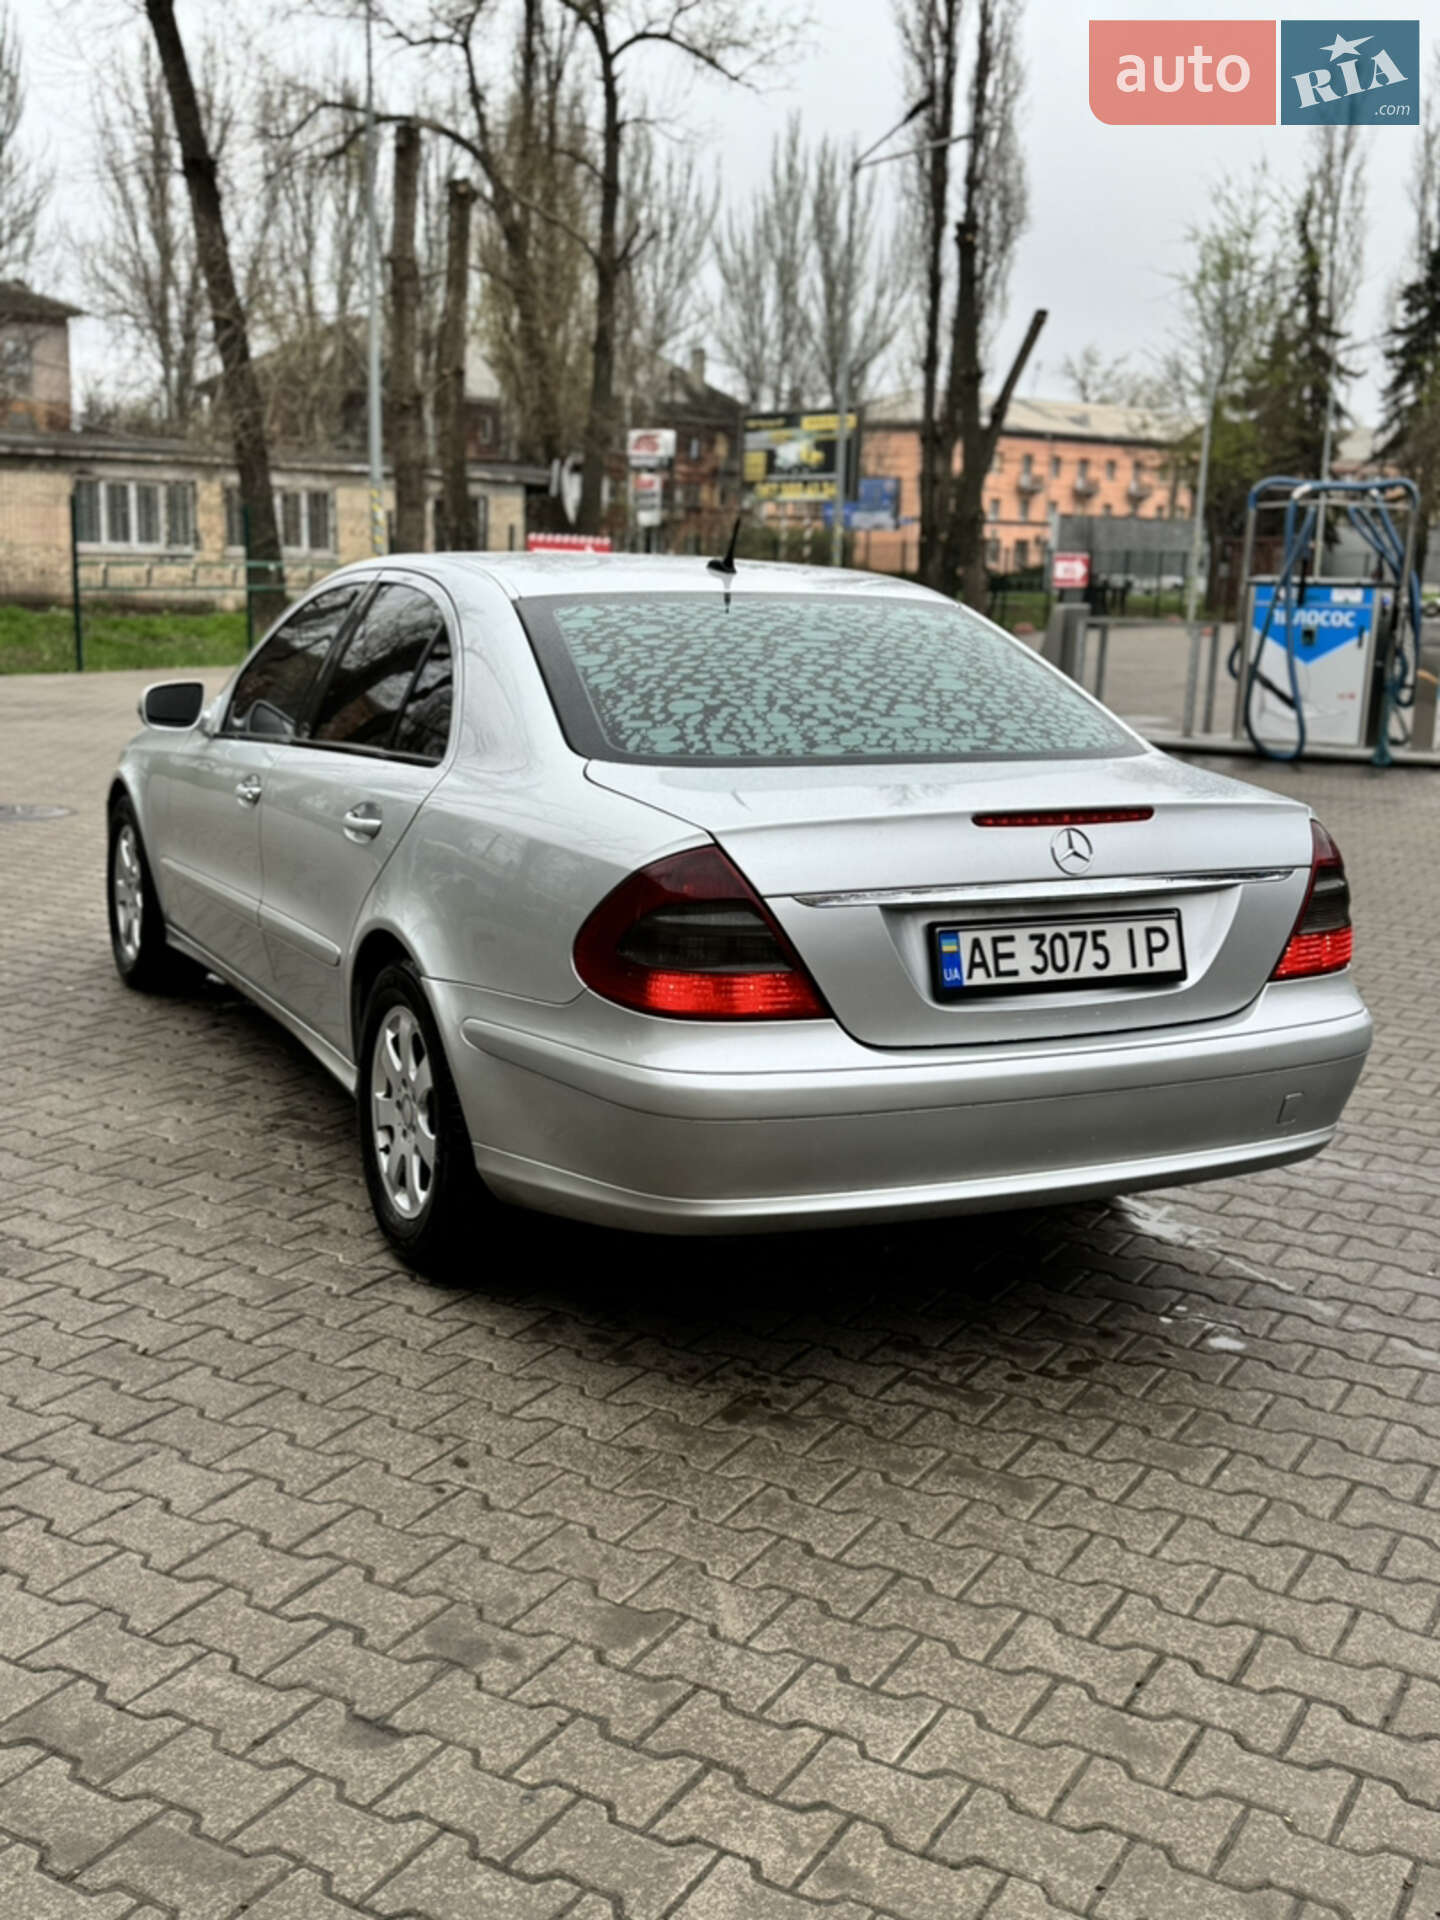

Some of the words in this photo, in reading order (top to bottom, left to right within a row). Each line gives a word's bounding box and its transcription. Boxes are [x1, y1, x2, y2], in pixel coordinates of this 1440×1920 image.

[966, 935, 1019, 980] AE
[1029, 930, 1110, 975] 3075
[1128, 926, 1170, 968] IP
[944, 968, 961, 981] UA
